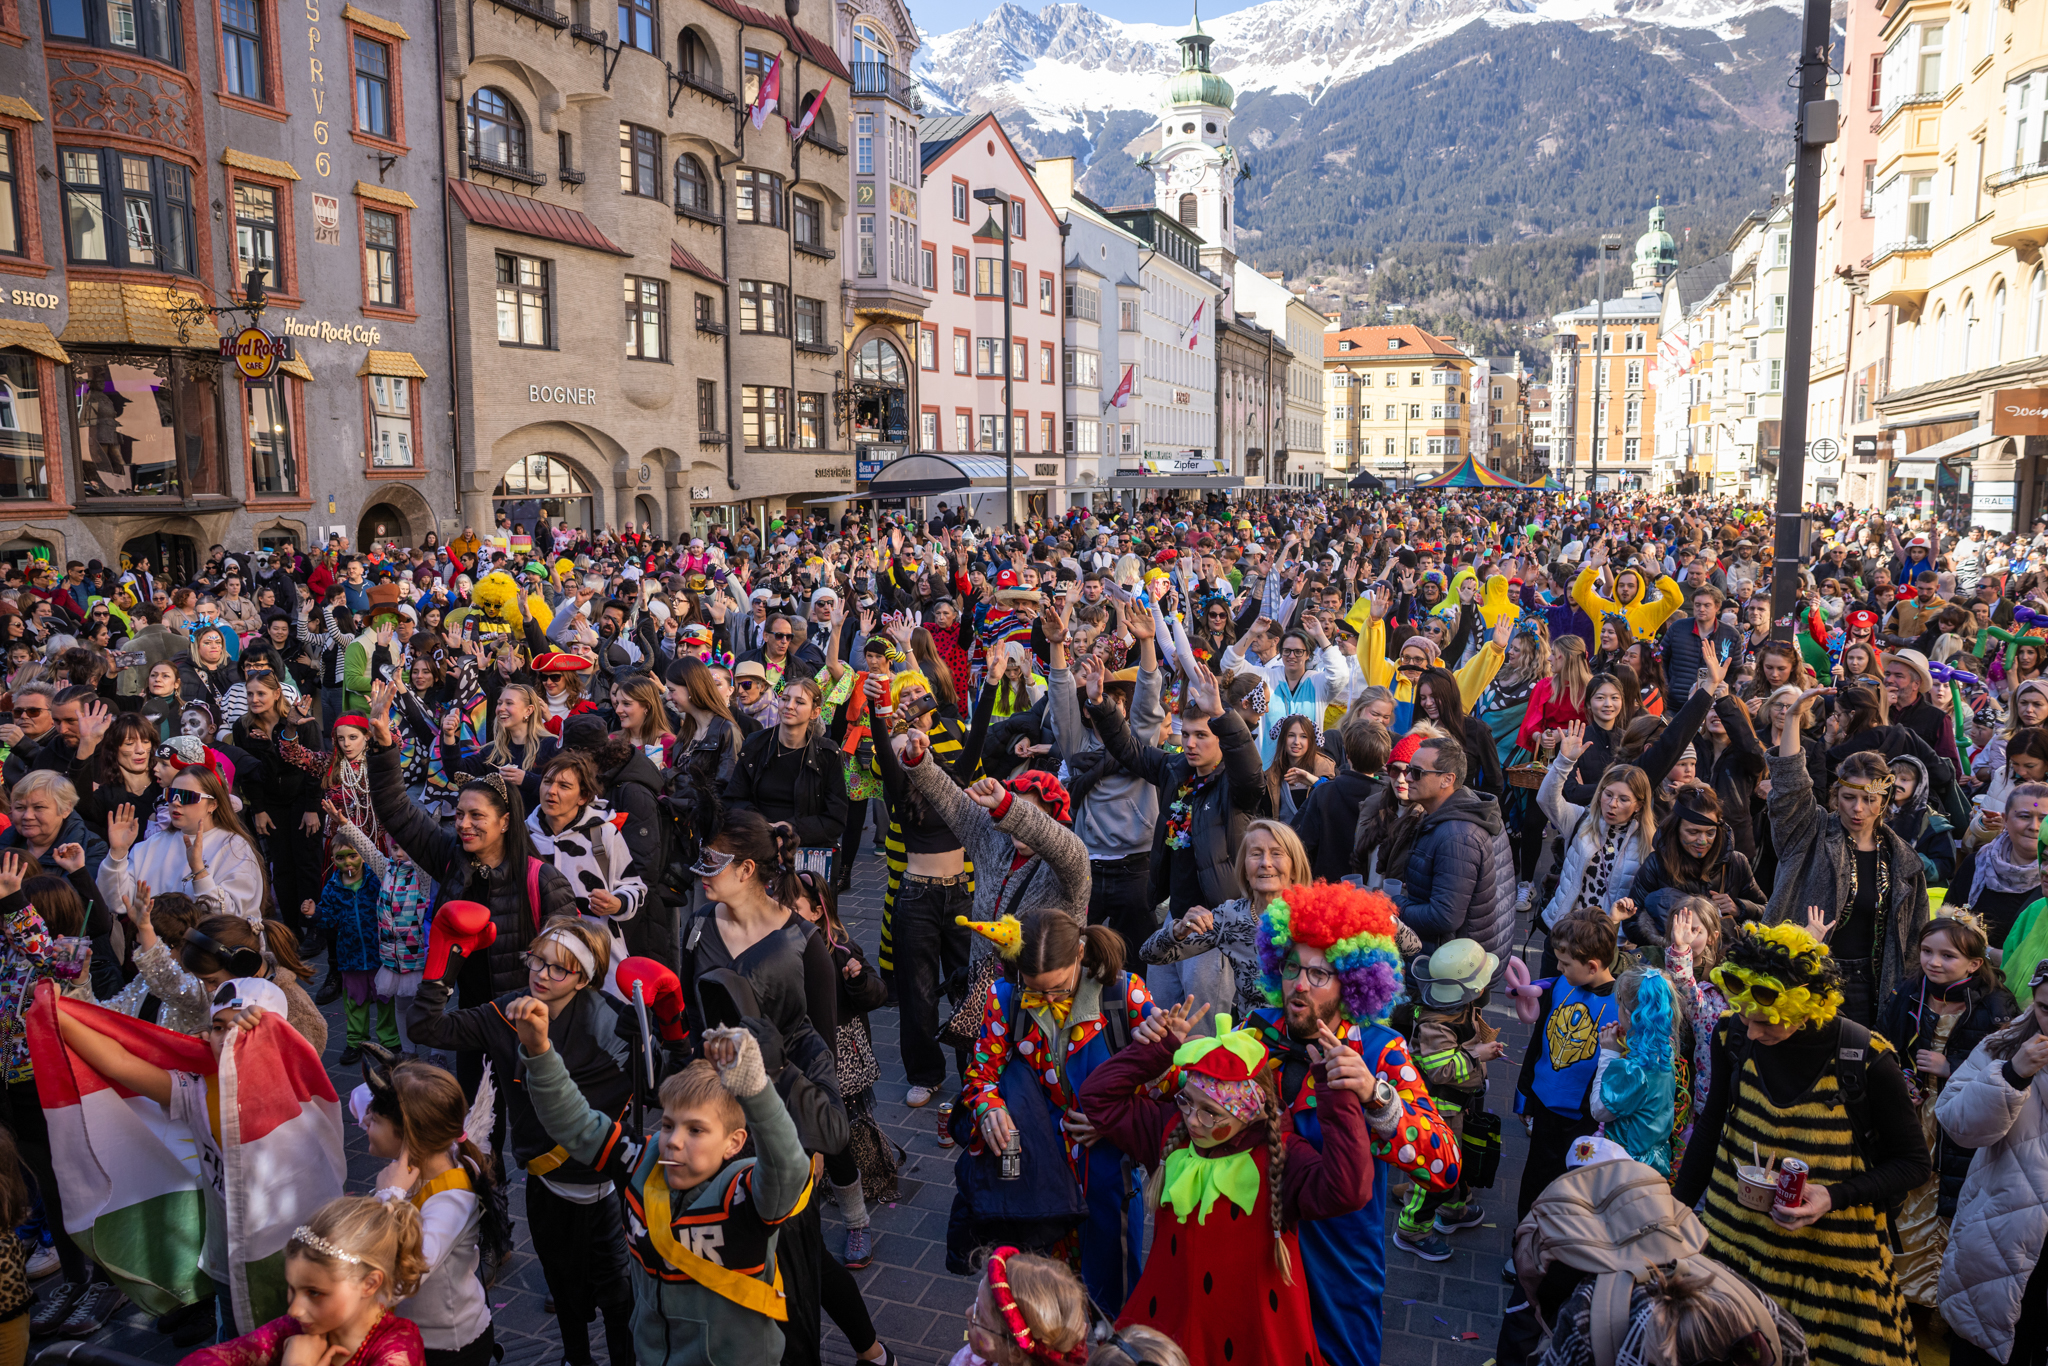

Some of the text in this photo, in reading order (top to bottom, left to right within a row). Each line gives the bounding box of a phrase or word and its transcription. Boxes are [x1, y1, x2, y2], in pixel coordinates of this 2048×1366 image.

[12, 290, 59, 309] SHOP
[284, 317, 381, 347] Hard Rock Cafe
[220, 338, 287, 359] Hard Rock
[246, 362, 265, 370] CAFE
[529, 385, 596, 405] BOGNER
[1174, 460, 1200, 471] Zipfer
